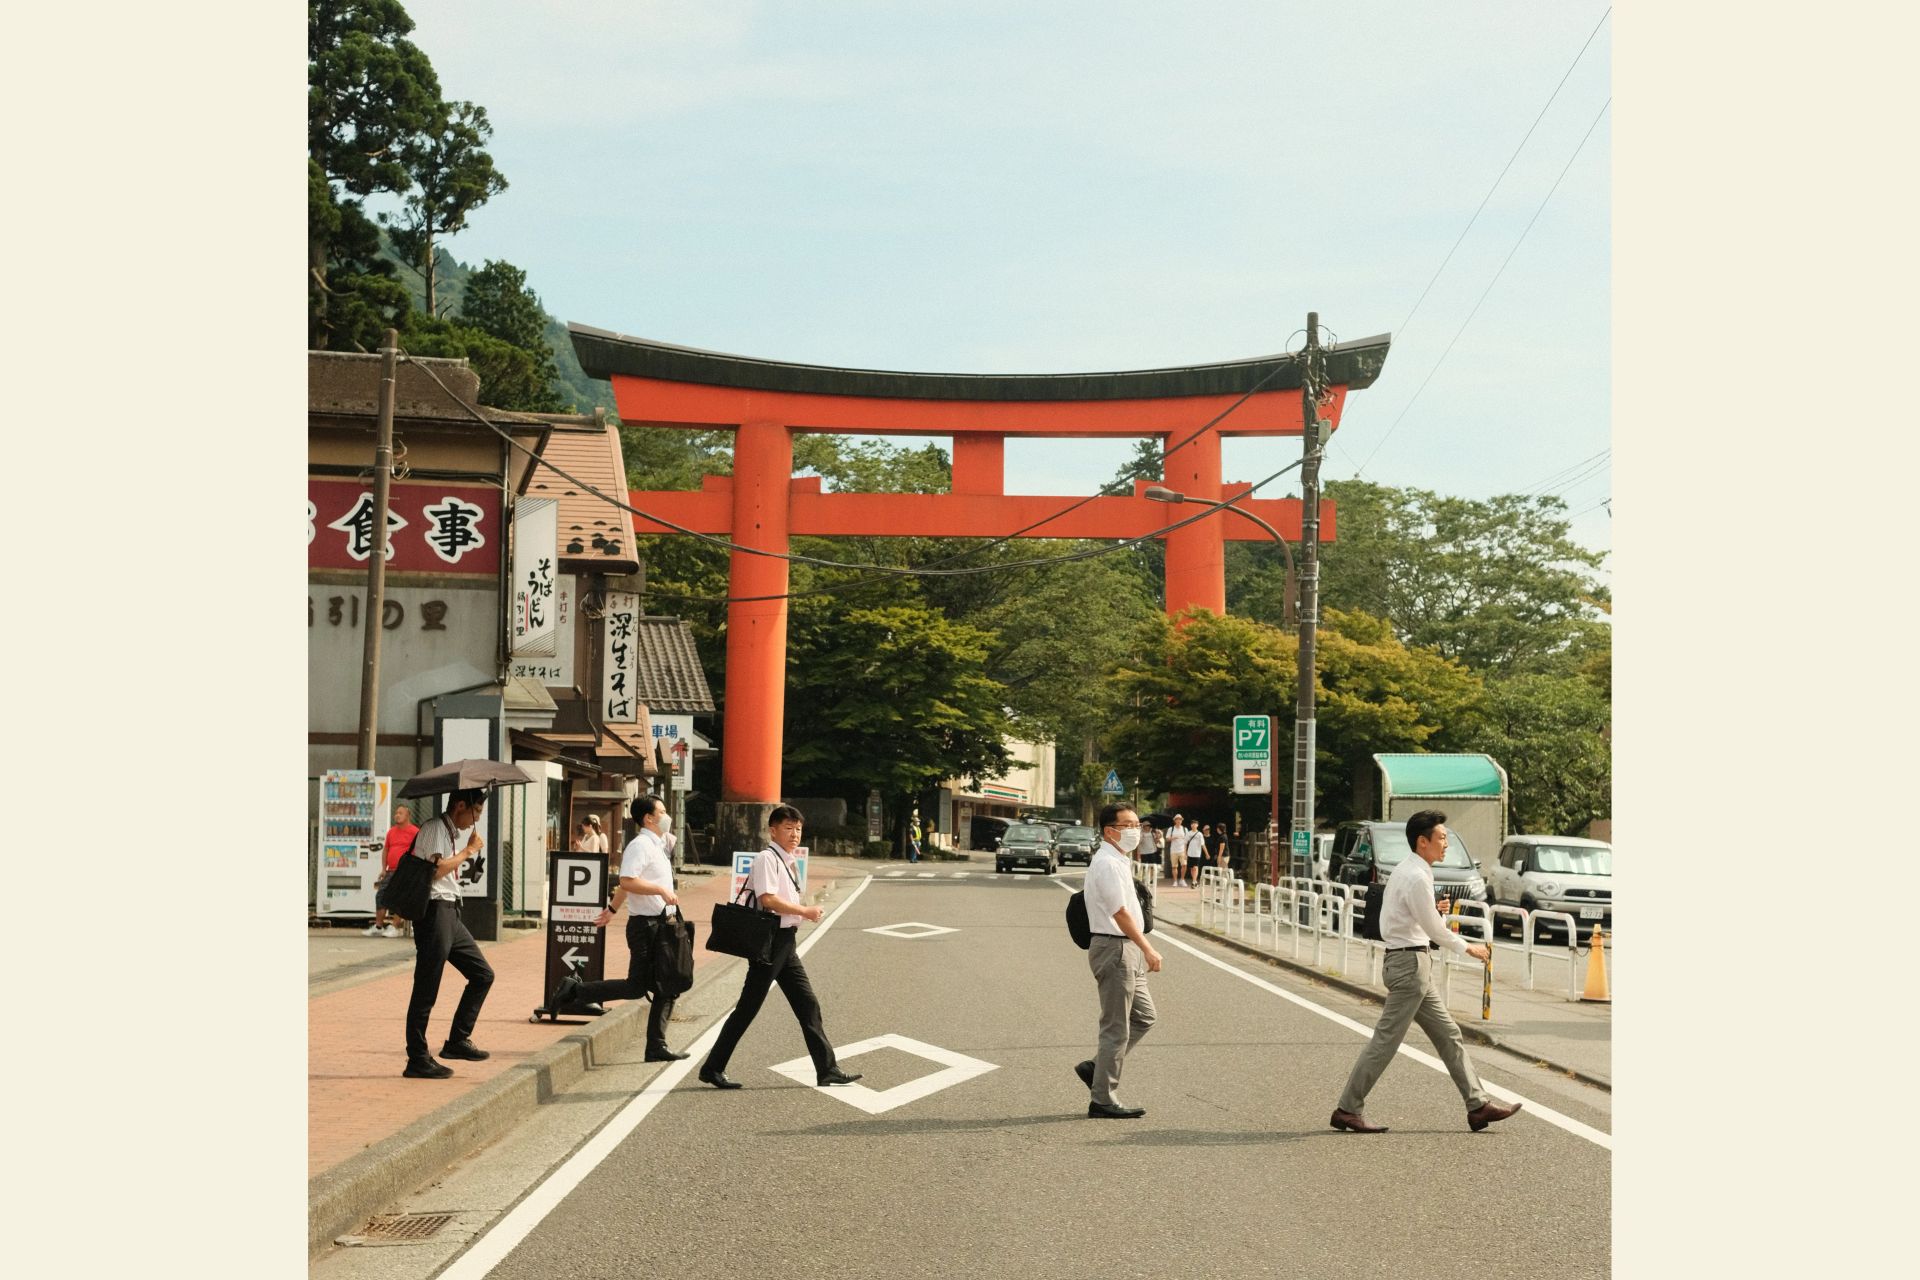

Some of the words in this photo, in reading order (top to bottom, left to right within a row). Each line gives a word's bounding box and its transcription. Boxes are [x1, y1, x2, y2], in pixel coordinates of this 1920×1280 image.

[308, 493, 484, 562] 食事
[538, 558, 554, 597] そば
[527, 571, 544, 628] うどん
[608, 613, 633, 719] 深生そば
[651, 724, 678, 739] 車場
[1238, 729, 1266, 747] P7
[568, 866, 591, 896] P
